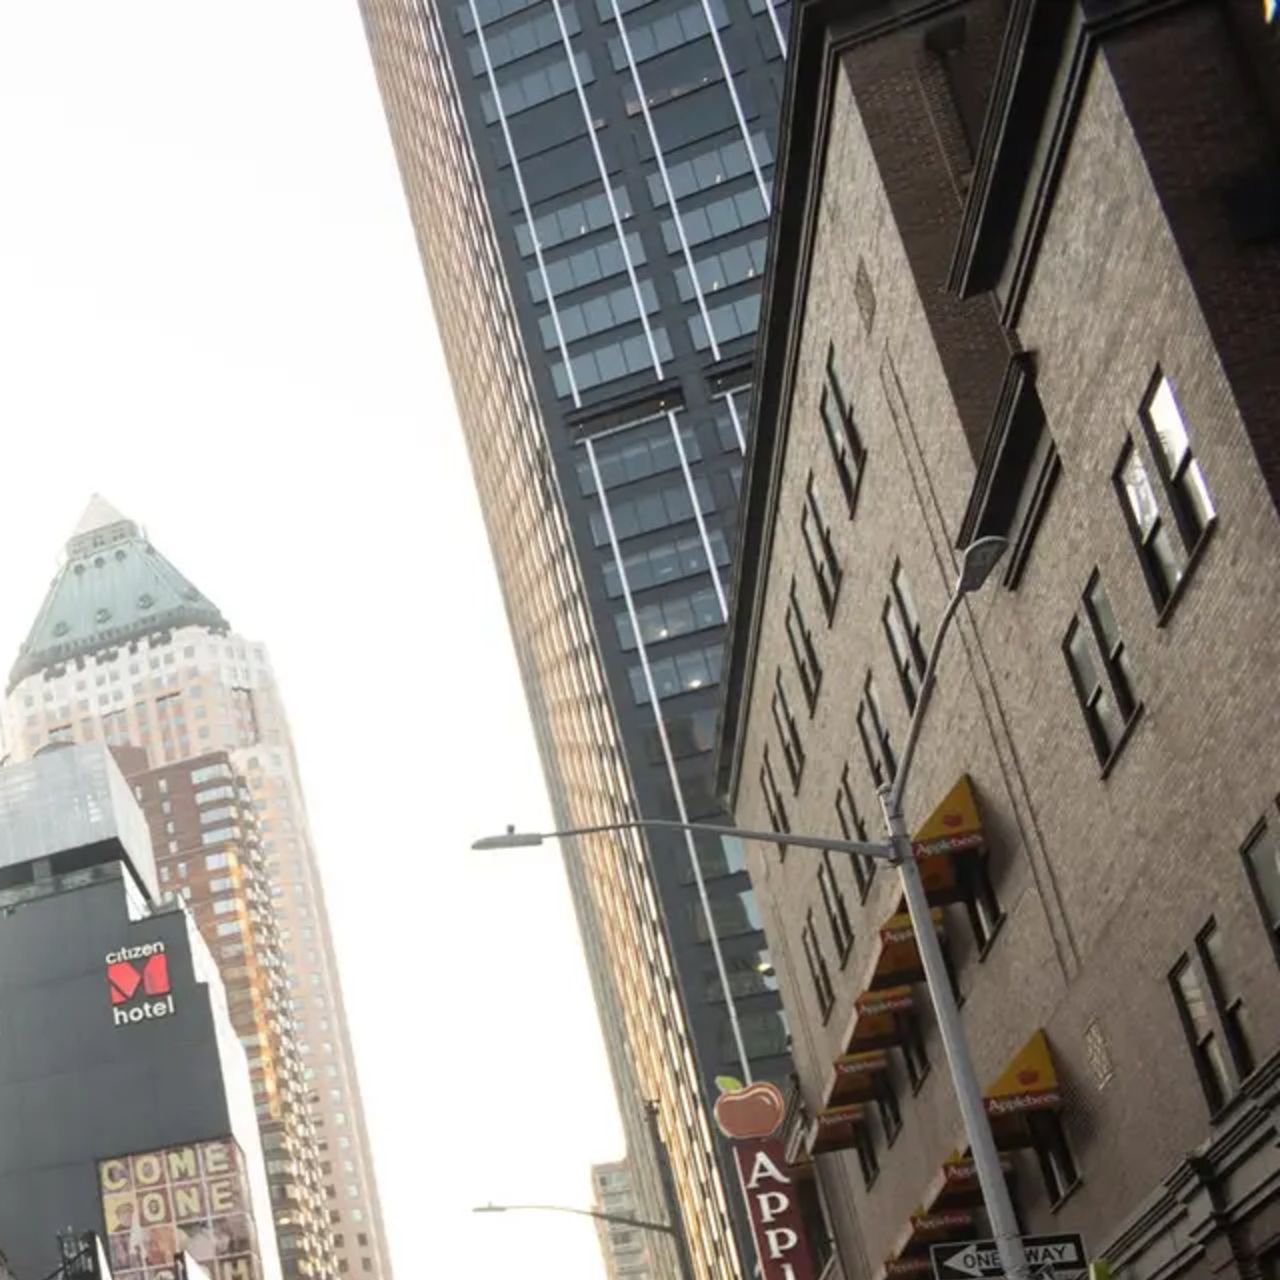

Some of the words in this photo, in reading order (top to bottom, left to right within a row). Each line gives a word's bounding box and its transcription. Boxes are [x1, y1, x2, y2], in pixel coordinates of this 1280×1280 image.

[105, 941, 165, 964] citizen
[113, 994, 175, 1025] hotel
[102, 1142, 230, 1190] COME
[142, 1181, 234, 1222] ONE
[963, 1251, 1000, 1268] ONE
[1024, 1246, 1067, 1262] WAY
